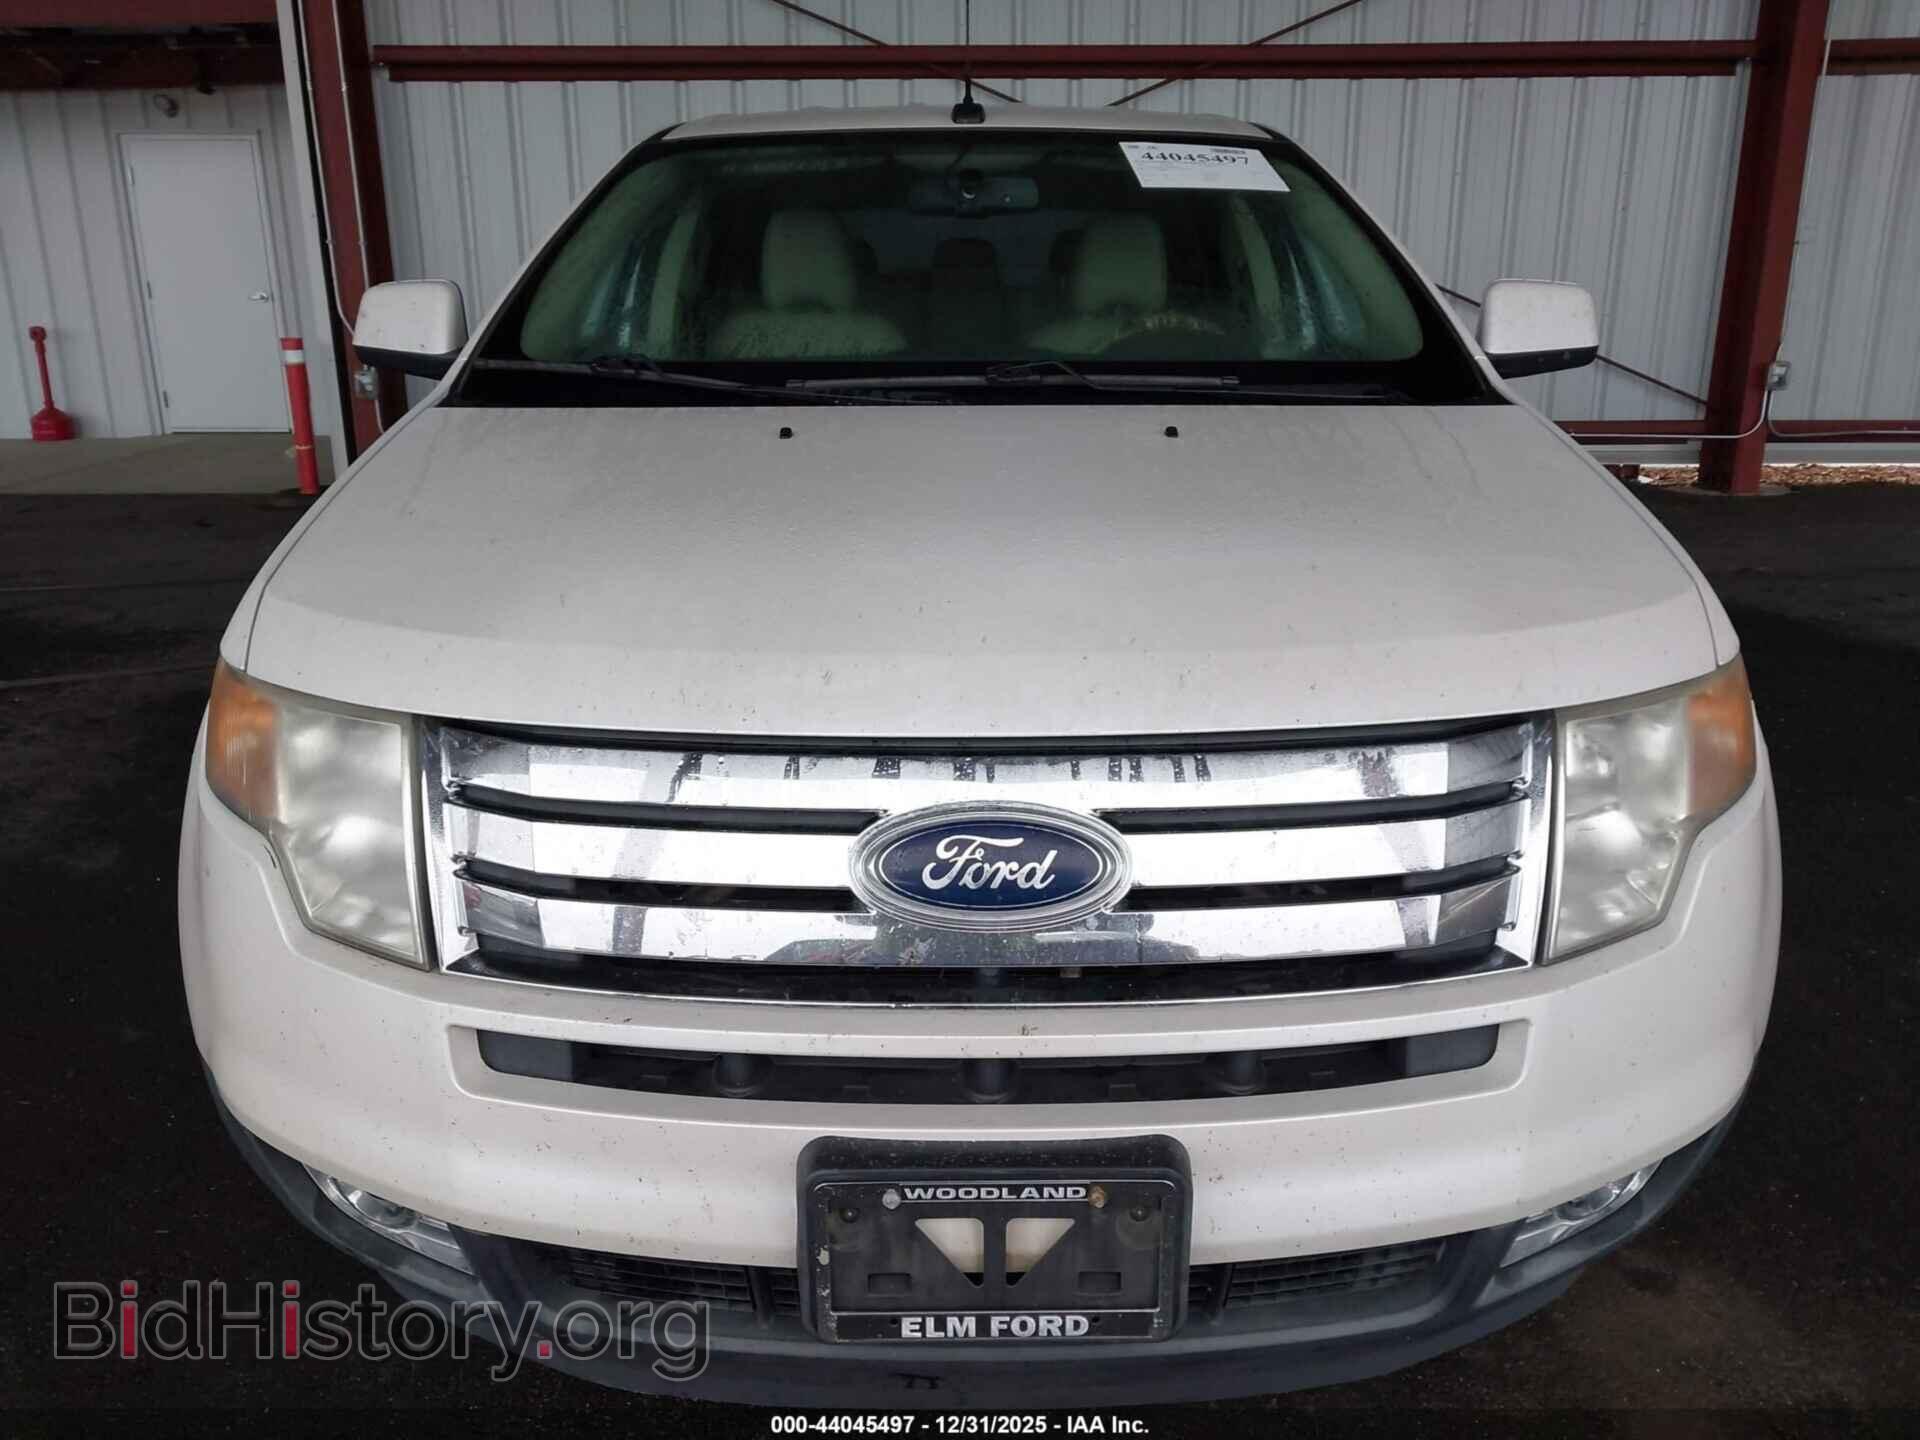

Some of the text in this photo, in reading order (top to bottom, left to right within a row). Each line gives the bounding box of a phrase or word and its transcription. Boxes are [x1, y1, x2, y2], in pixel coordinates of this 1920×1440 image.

[1141, 152, 1248, 165] 44045497
[921, 834, 1057, 890] Ford
[904, 1186, 1087, 1199] WOODLAND
[901, 1315, 1090, 1338] ELM FORD
